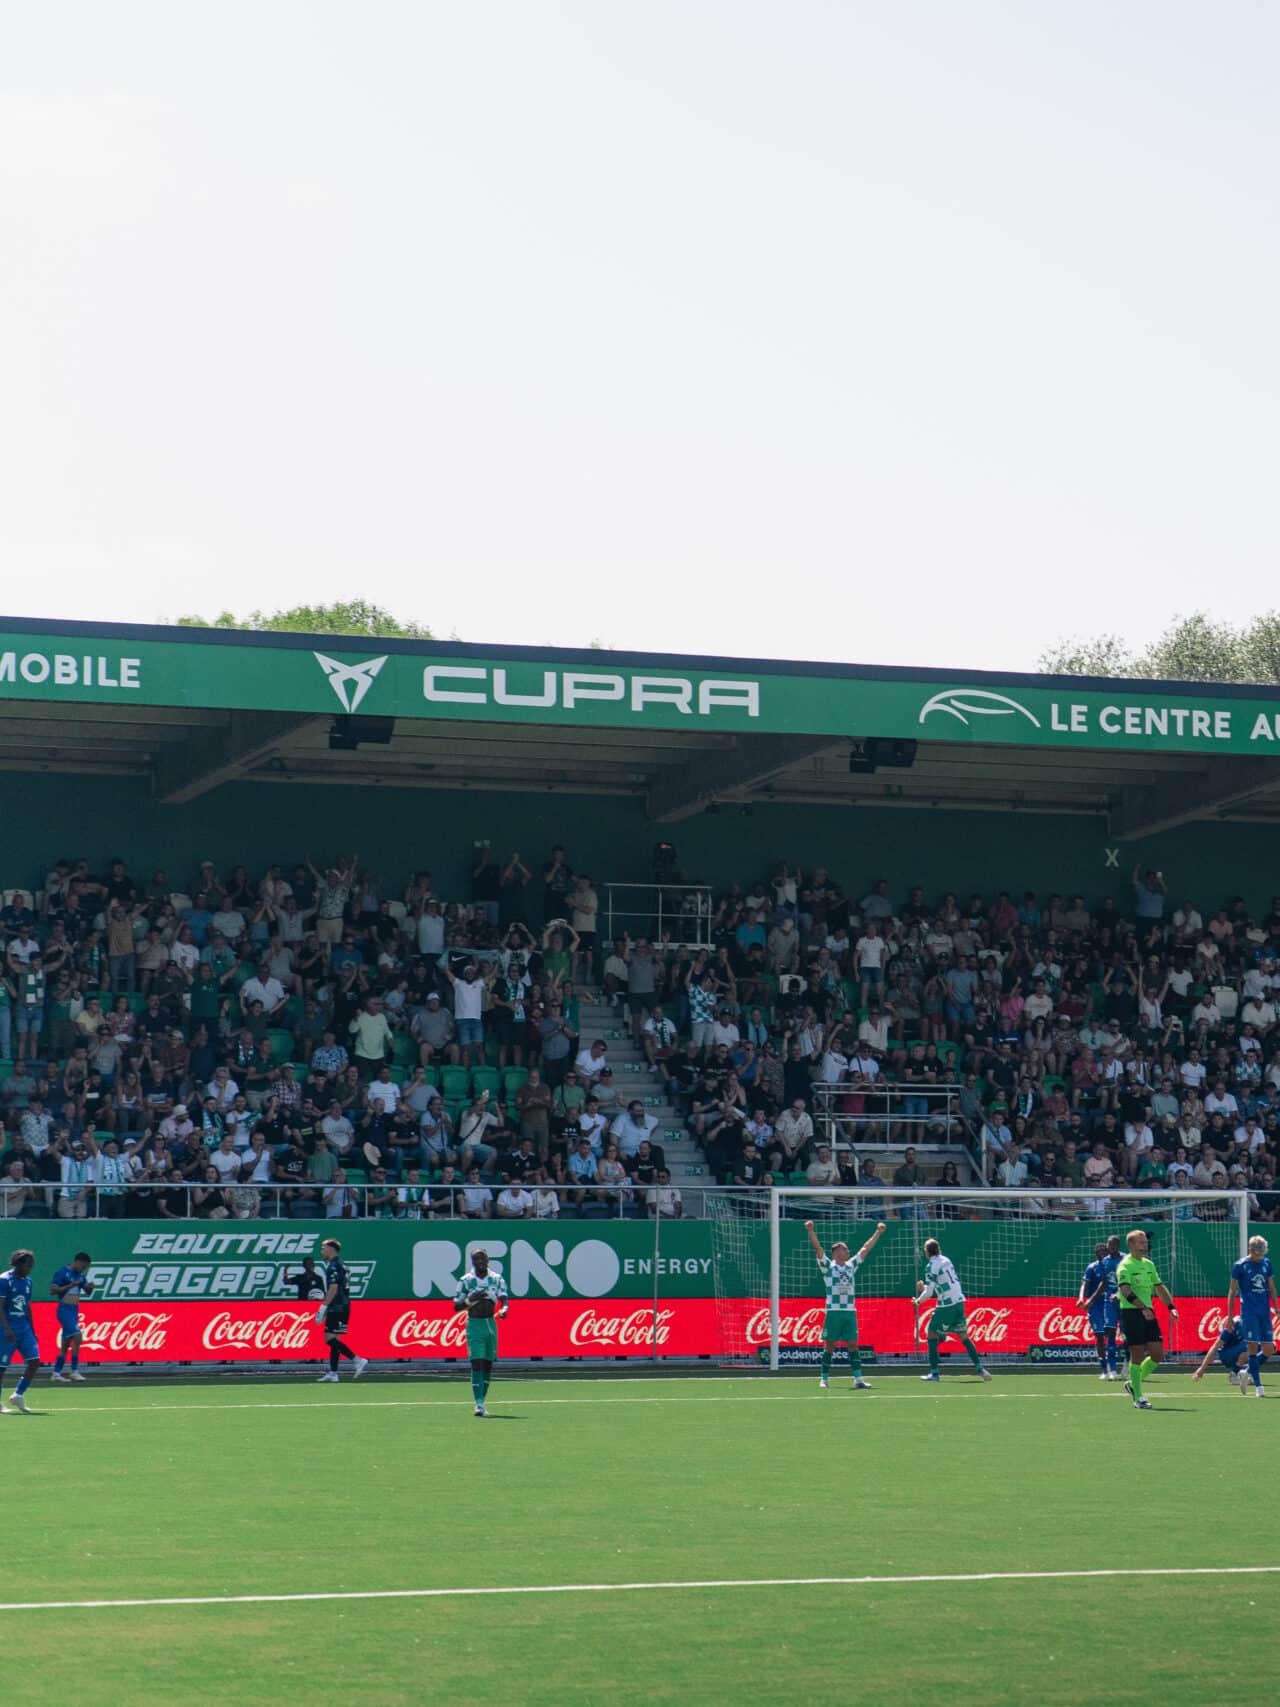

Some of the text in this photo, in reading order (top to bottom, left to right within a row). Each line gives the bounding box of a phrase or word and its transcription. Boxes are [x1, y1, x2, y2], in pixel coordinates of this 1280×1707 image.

[423, 665, 760, 717] CUPRA
[1052, 703, 1088, 732] LE
[1099, 706, 1231, 738] CENTRE
[132, 1234, 320, 1254] EGOUTTAGE
[82, 1262, 375, 1299] FRAGAPE
[412, 1239, 621, 1298] RENO
[623, 1258, 714, 1275] ENERGY
[202, 1312, 315, 1349] Coca-Cola
[390, 1310, 468, 1347] Coca-C
[570, 1309, 675, 1346] Coca-Cola
